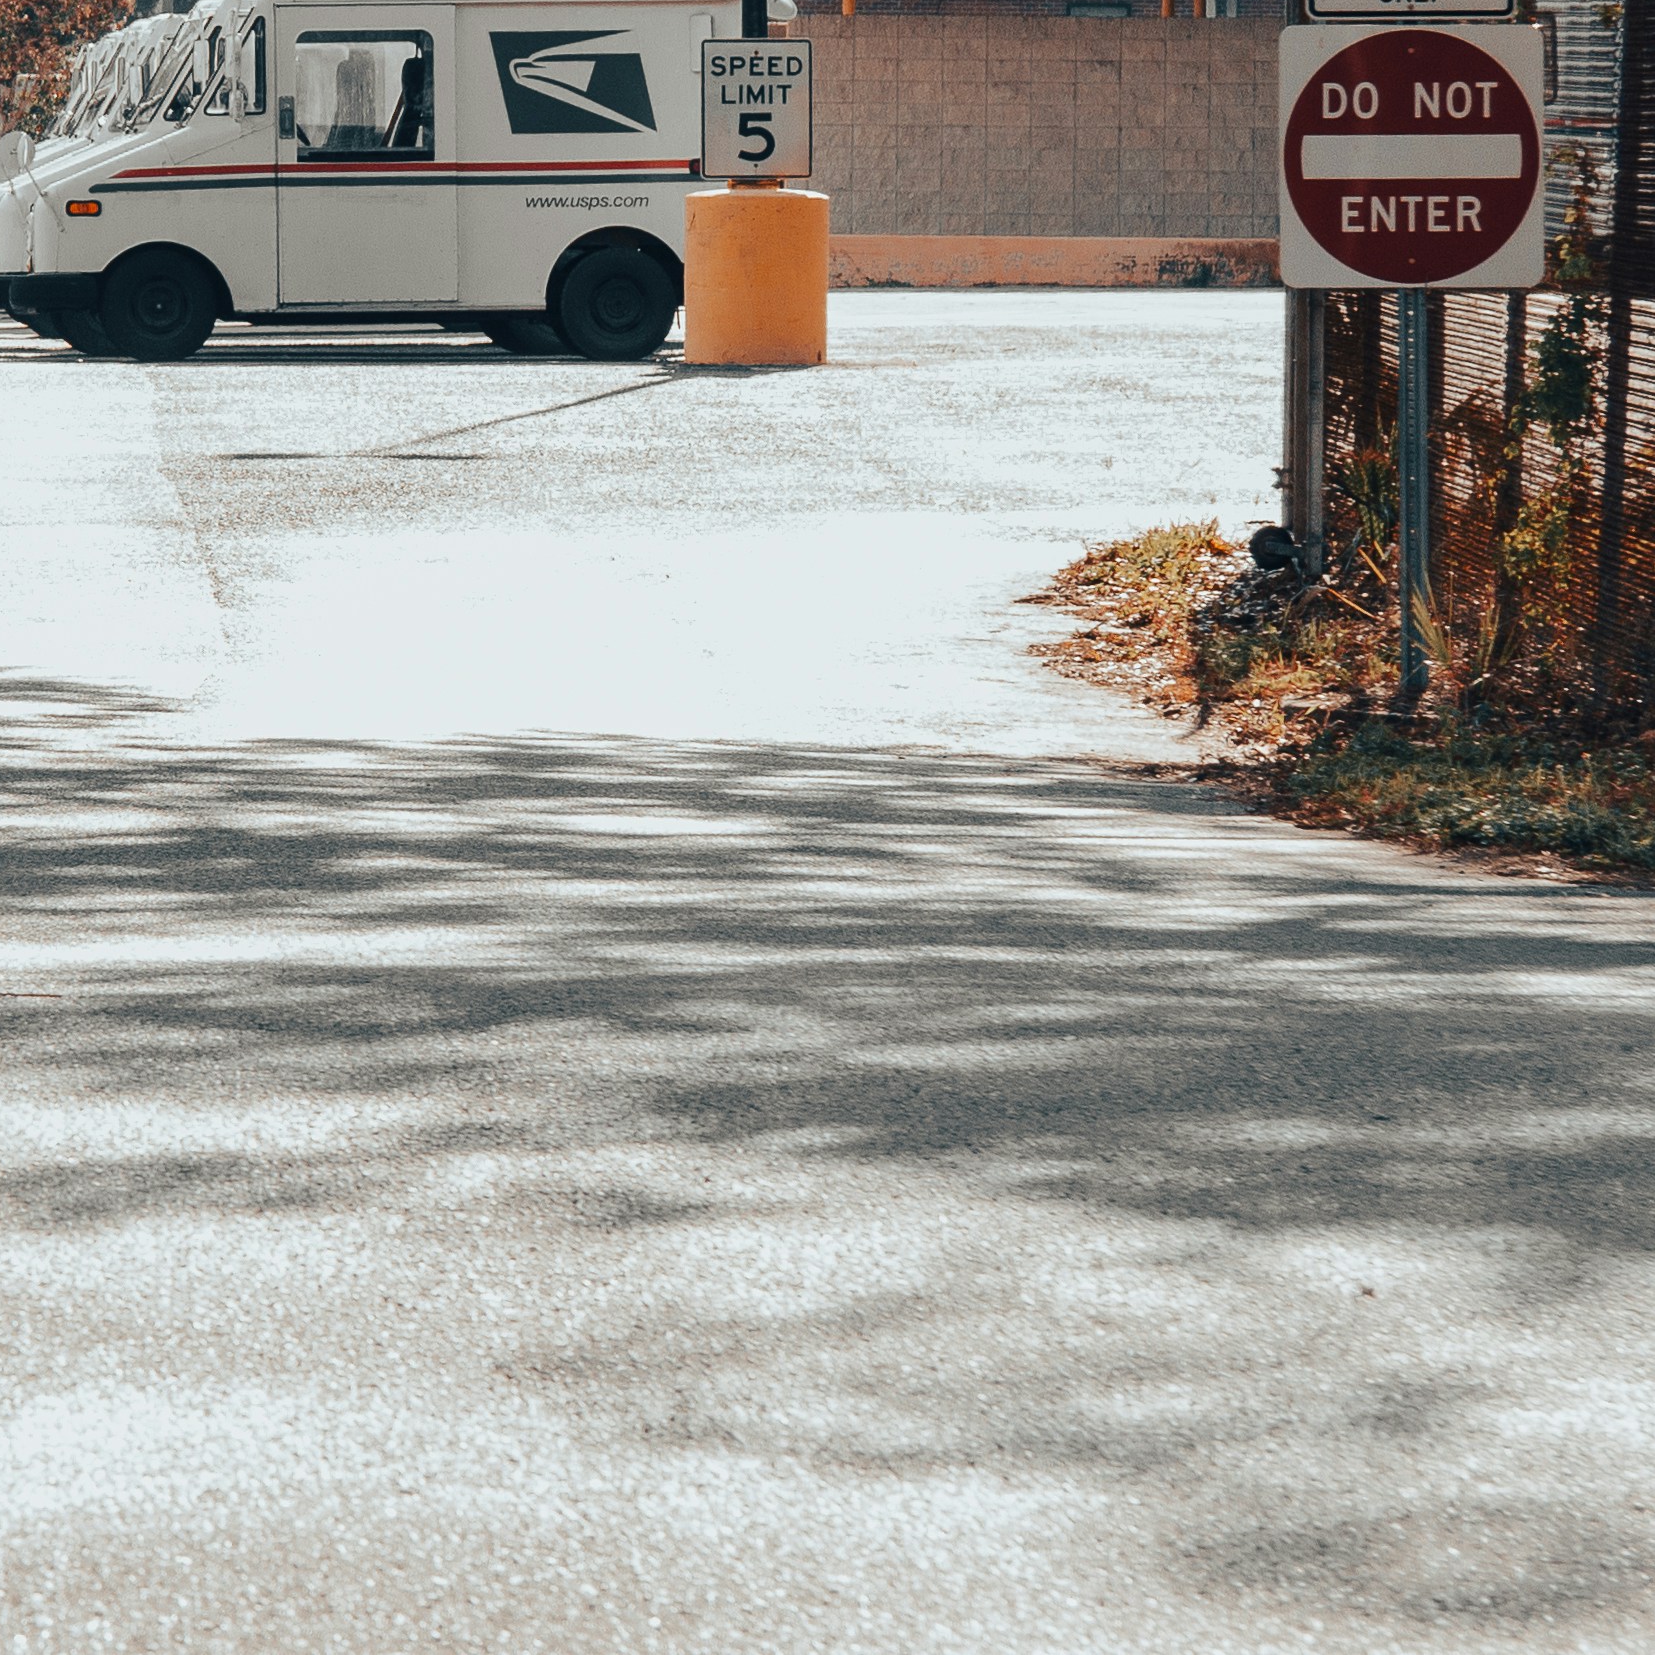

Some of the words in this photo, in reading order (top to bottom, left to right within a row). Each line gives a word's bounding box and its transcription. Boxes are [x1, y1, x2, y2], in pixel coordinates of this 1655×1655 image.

[710, 55, 803, 77] SPEED
[721, 84, 792, 105] LIMIT
[1321, 81, 1380, 120] DO
[1413, 81, 1500, 119] NOT
[737, 112, 776, 162] 5
[525, 196, 649, 210] www.usps.com
[1340, 195, 1483, 233] ENTER
